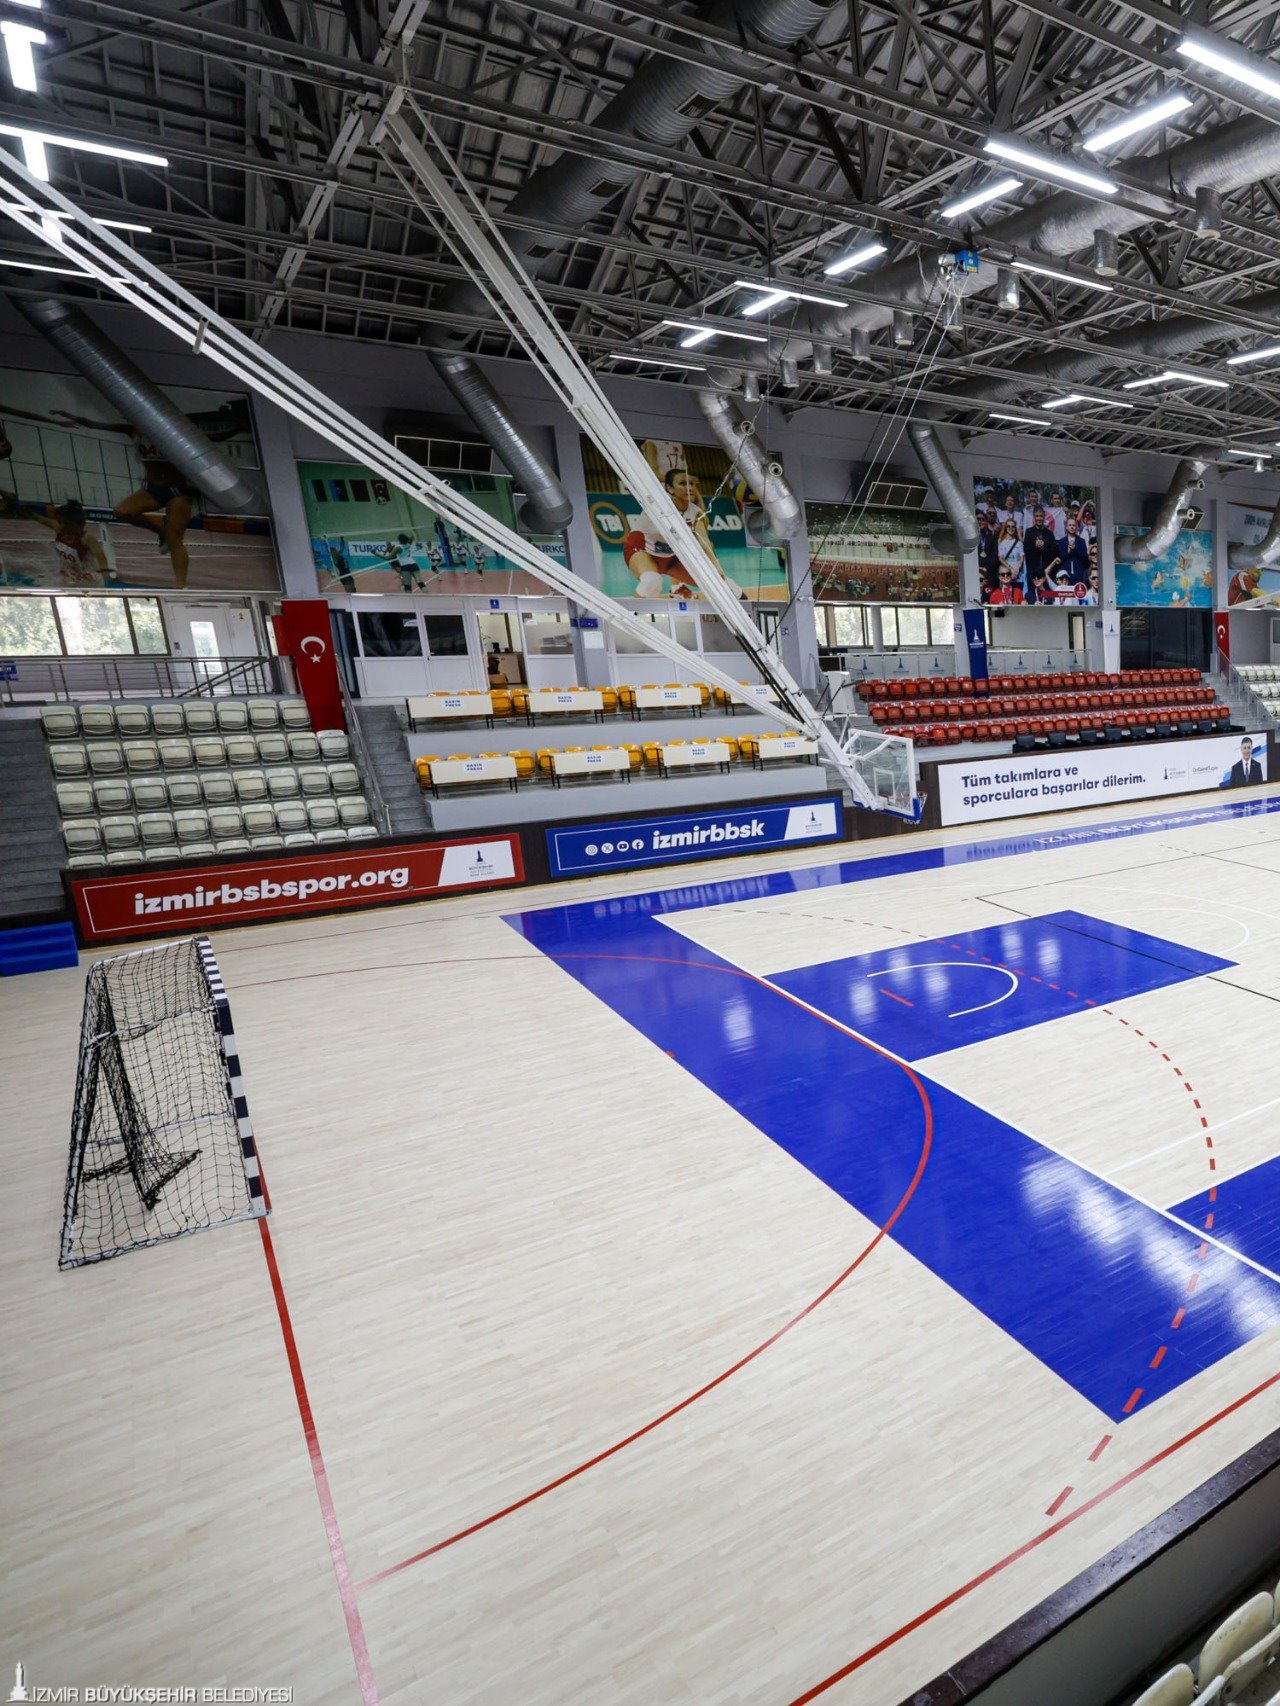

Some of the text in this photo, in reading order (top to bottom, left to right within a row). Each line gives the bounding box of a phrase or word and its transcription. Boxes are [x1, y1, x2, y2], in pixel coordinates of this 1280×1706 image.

[961, 765, 1079, 789] Tüm takımlara ve
[962, 773, 1147, 806] sporculara başarılar dilerim.
[652, 818, 765, 850] izmirbbsk
[134, 866, 410, 915] izmirbsbspor.org
